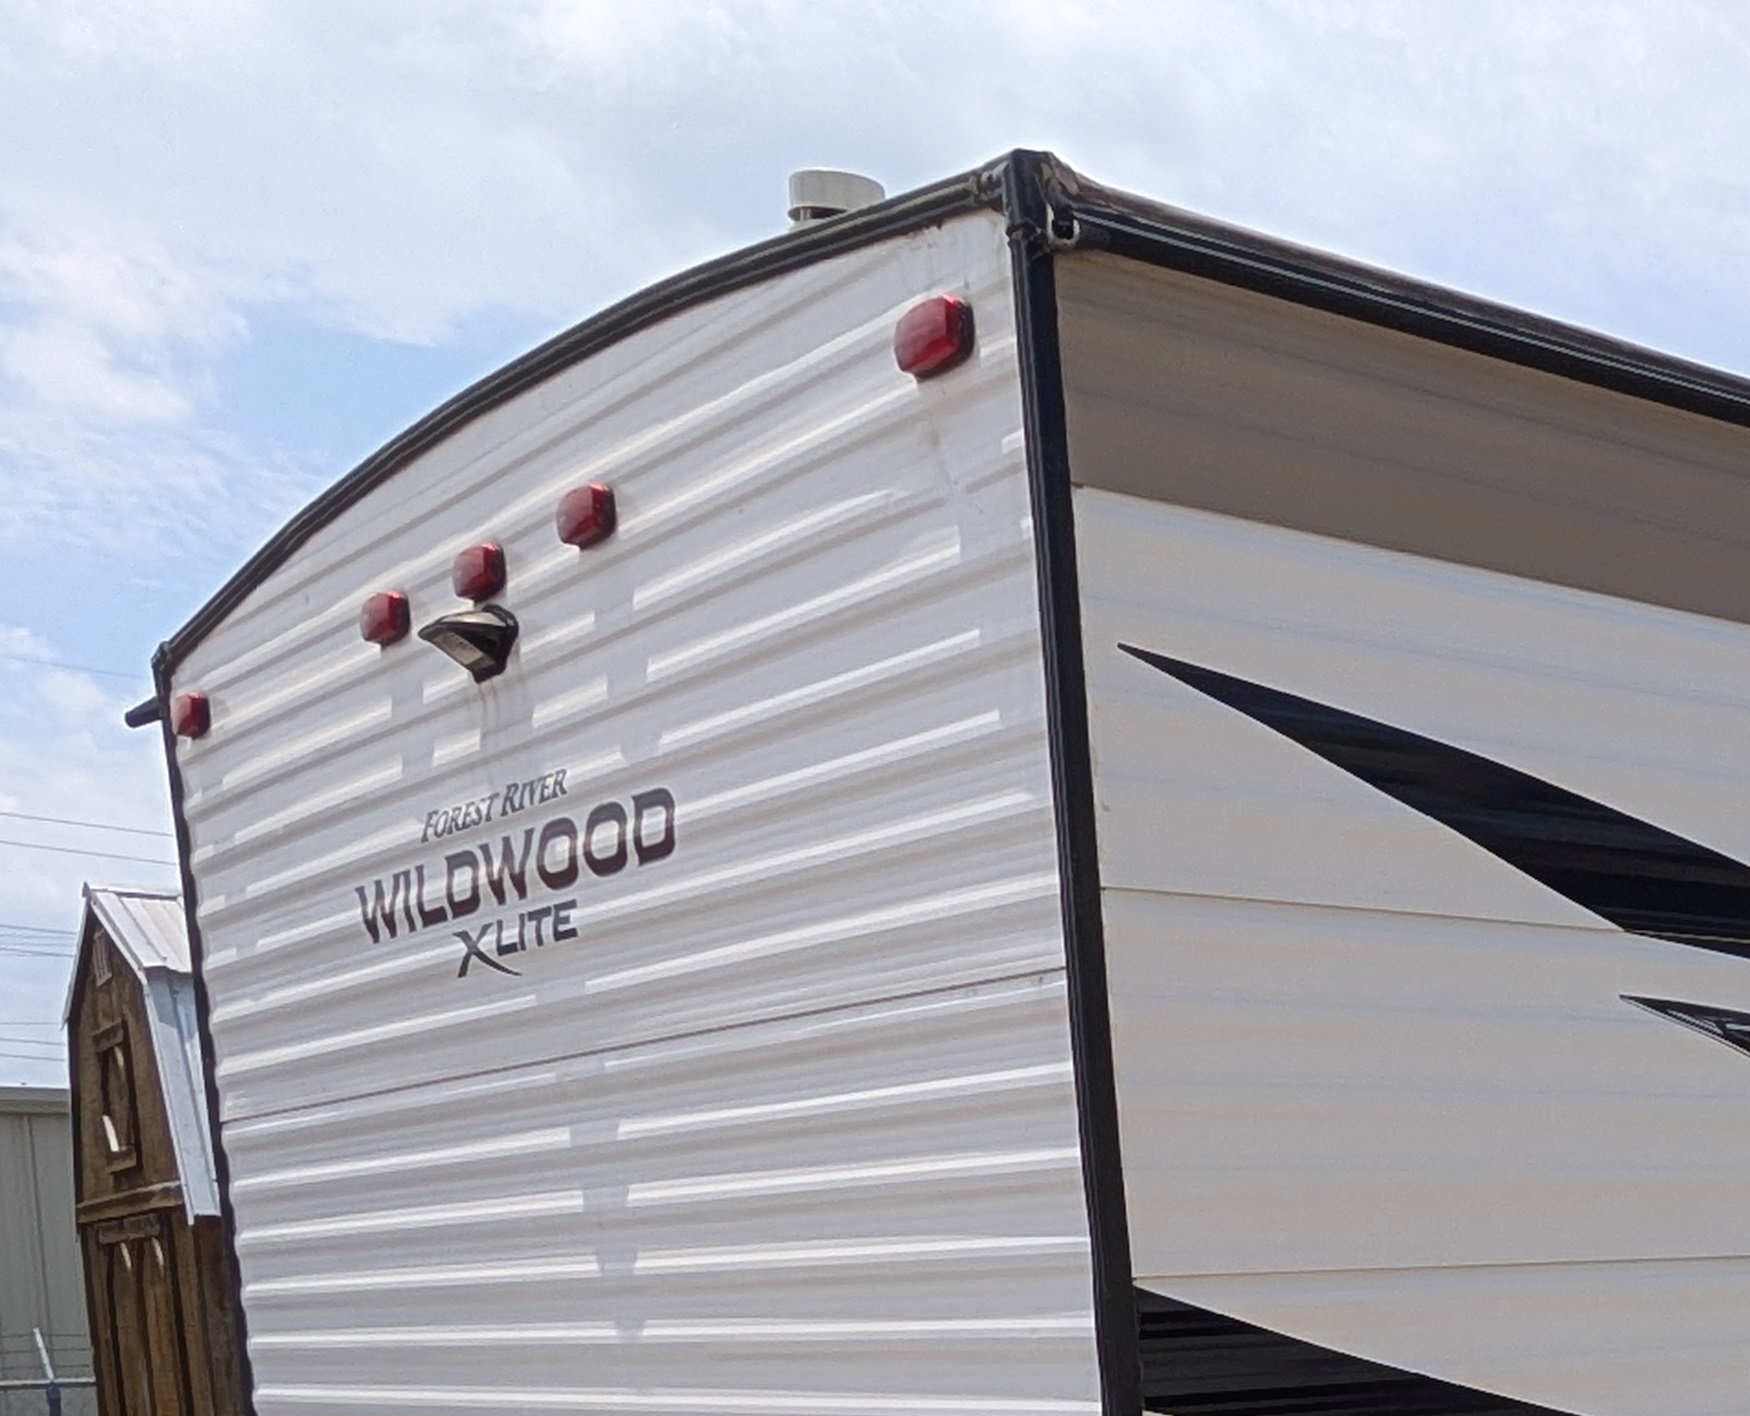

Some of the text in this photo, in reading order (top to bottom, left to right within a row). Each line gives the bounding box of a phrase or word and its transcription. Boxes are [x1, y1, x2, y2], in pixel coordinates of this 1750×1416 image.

[421, 768, 568, 843] FOREST RIVER
[355, 787, 676, 944] WILDWOOD
